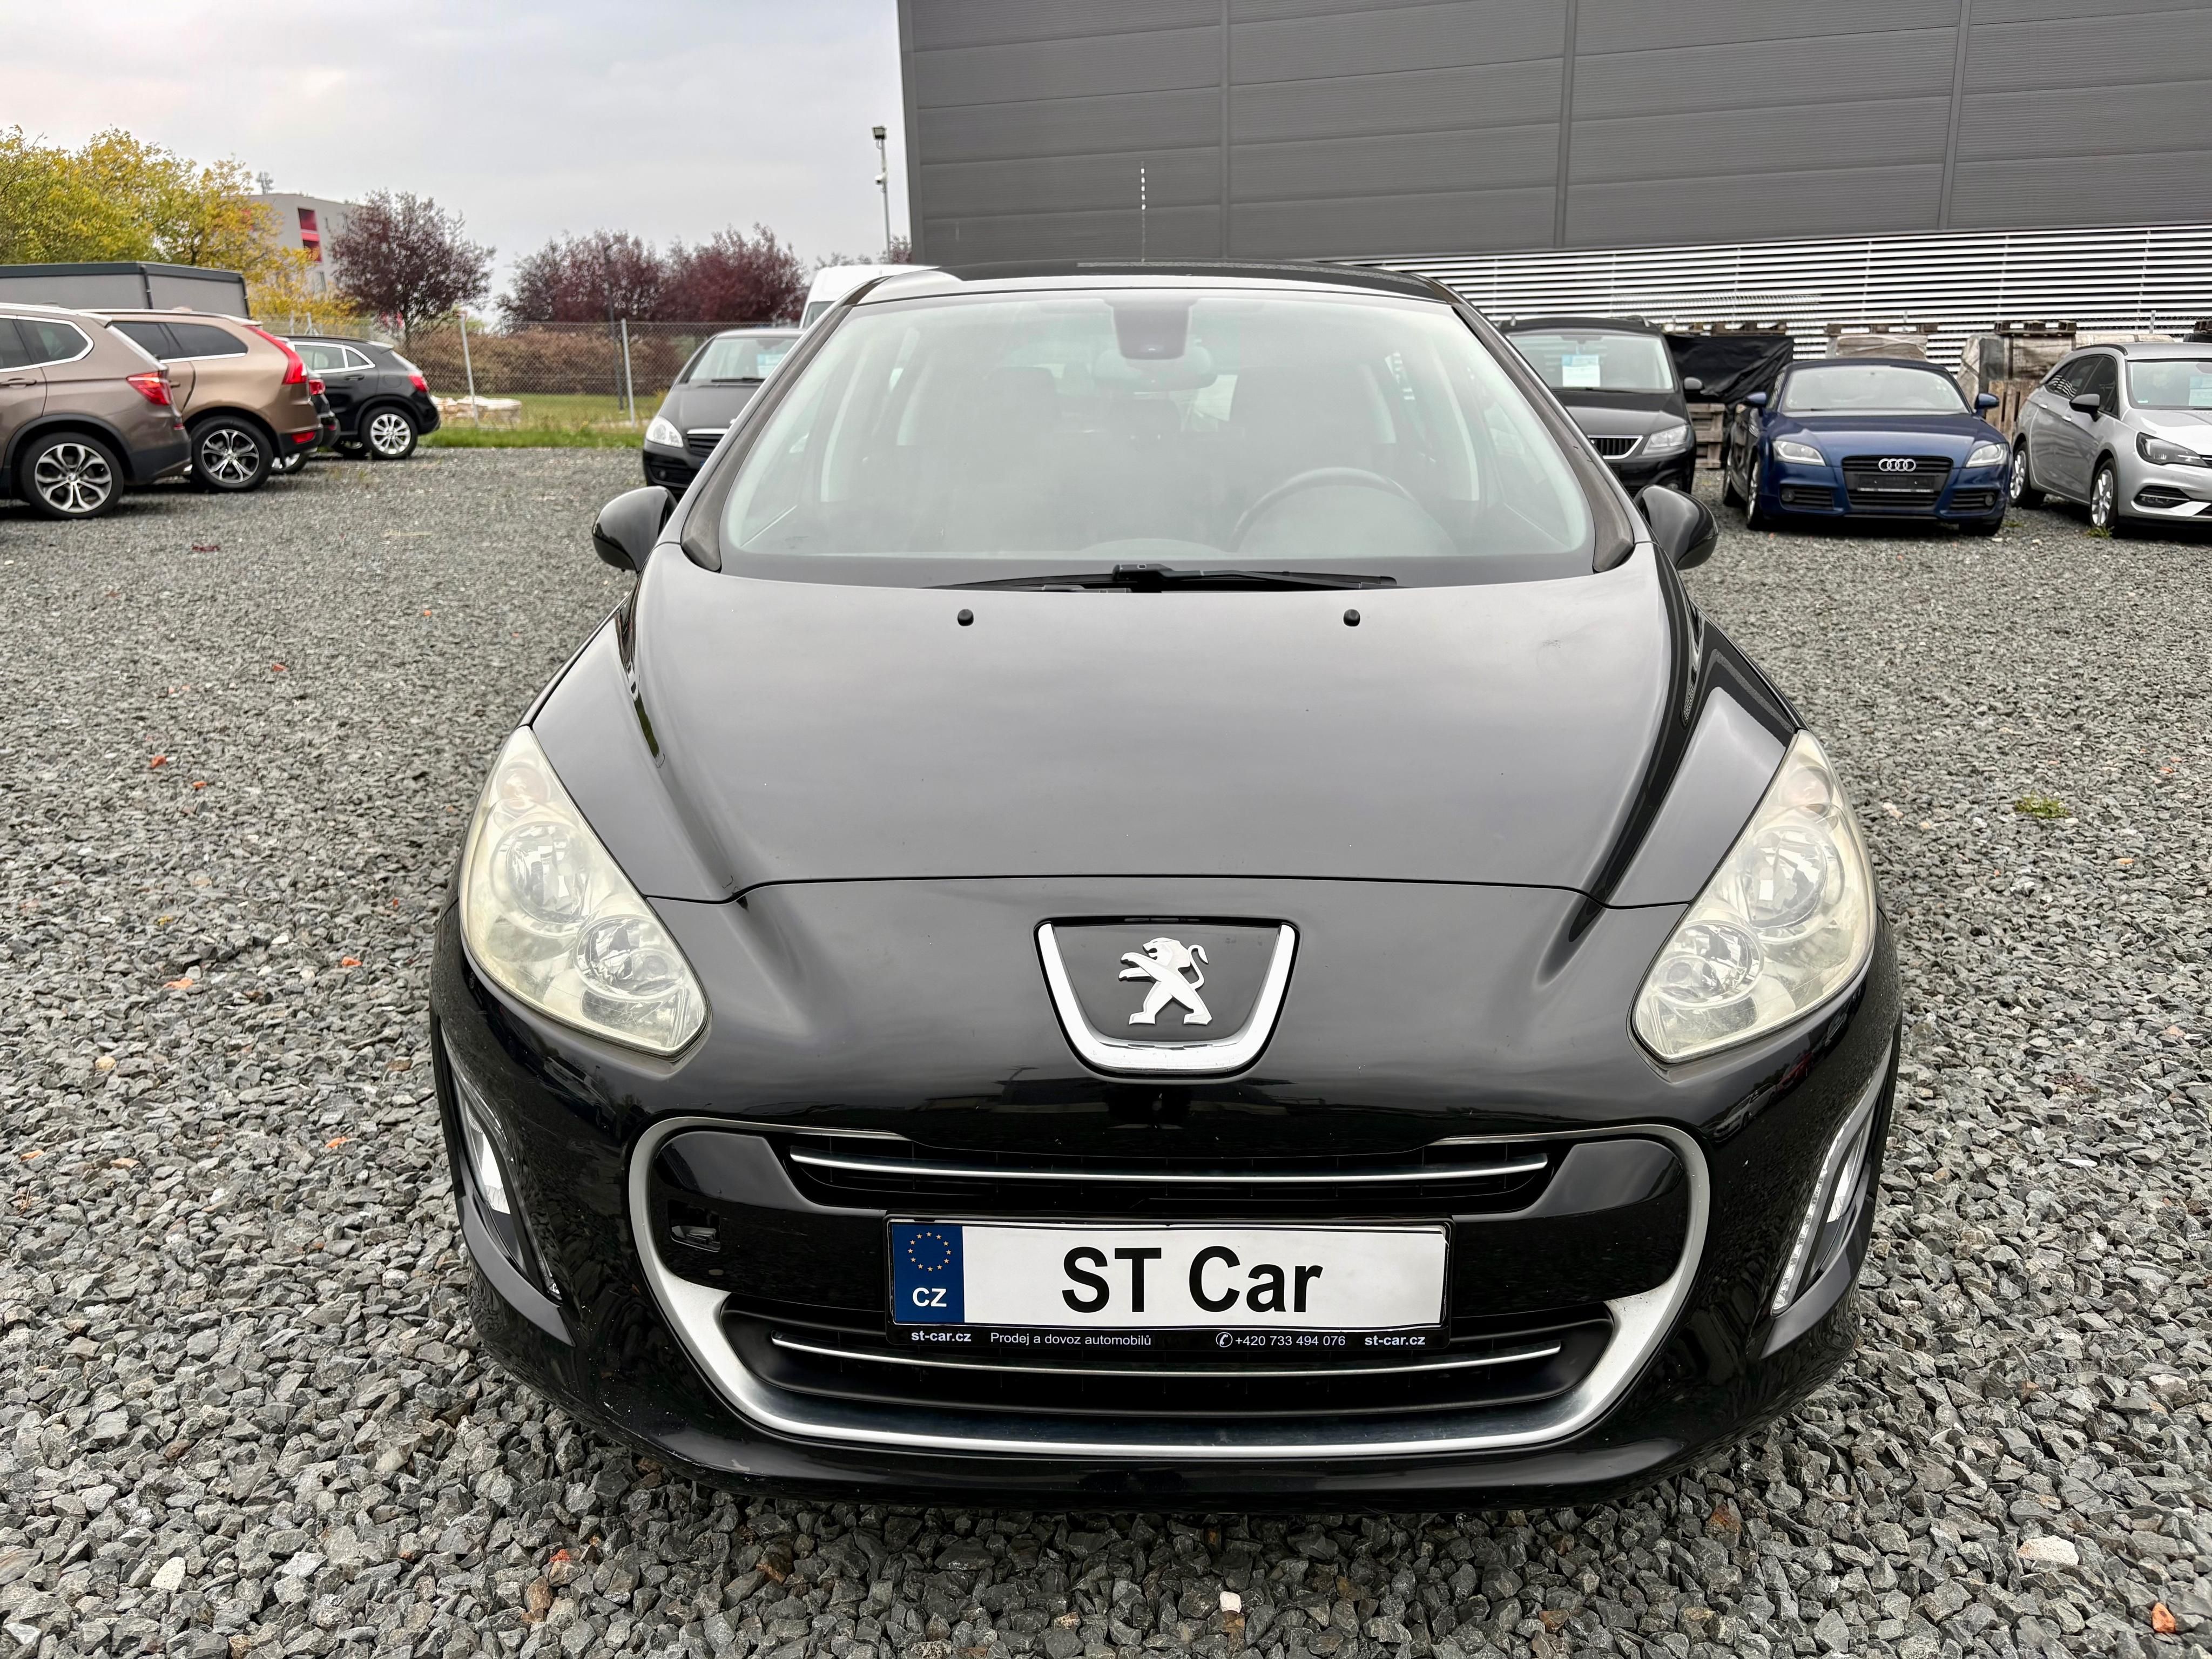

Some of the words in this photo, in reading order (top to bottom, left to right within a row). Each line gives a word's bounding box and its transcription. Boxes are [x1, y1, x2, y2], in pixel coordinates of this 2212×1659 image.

[1062, 1246, 1162, 1313] ST
[1189, 1245, 1323, 1313] Car
[913, 1287, 947, 1307] CZ
[911, 1331, 972, 1342] st-car.cz
[990, 1332, 1029, 1346] Prodej
[1033, 1336, 1041, 1344] a
[1044, 1334, 1081, 1344] dovoz
[1085, 1334, 1151, 1345] automobilů
[1235, 1336, 1266, 1346] +420
[1270, 1336, 1292, 1346] 733
[1296, 1336, 1319, 1346] 494
[1323, 1336, 1346, 1346] 076
[1365, 1336, 1426, 1346] st-car.cz
